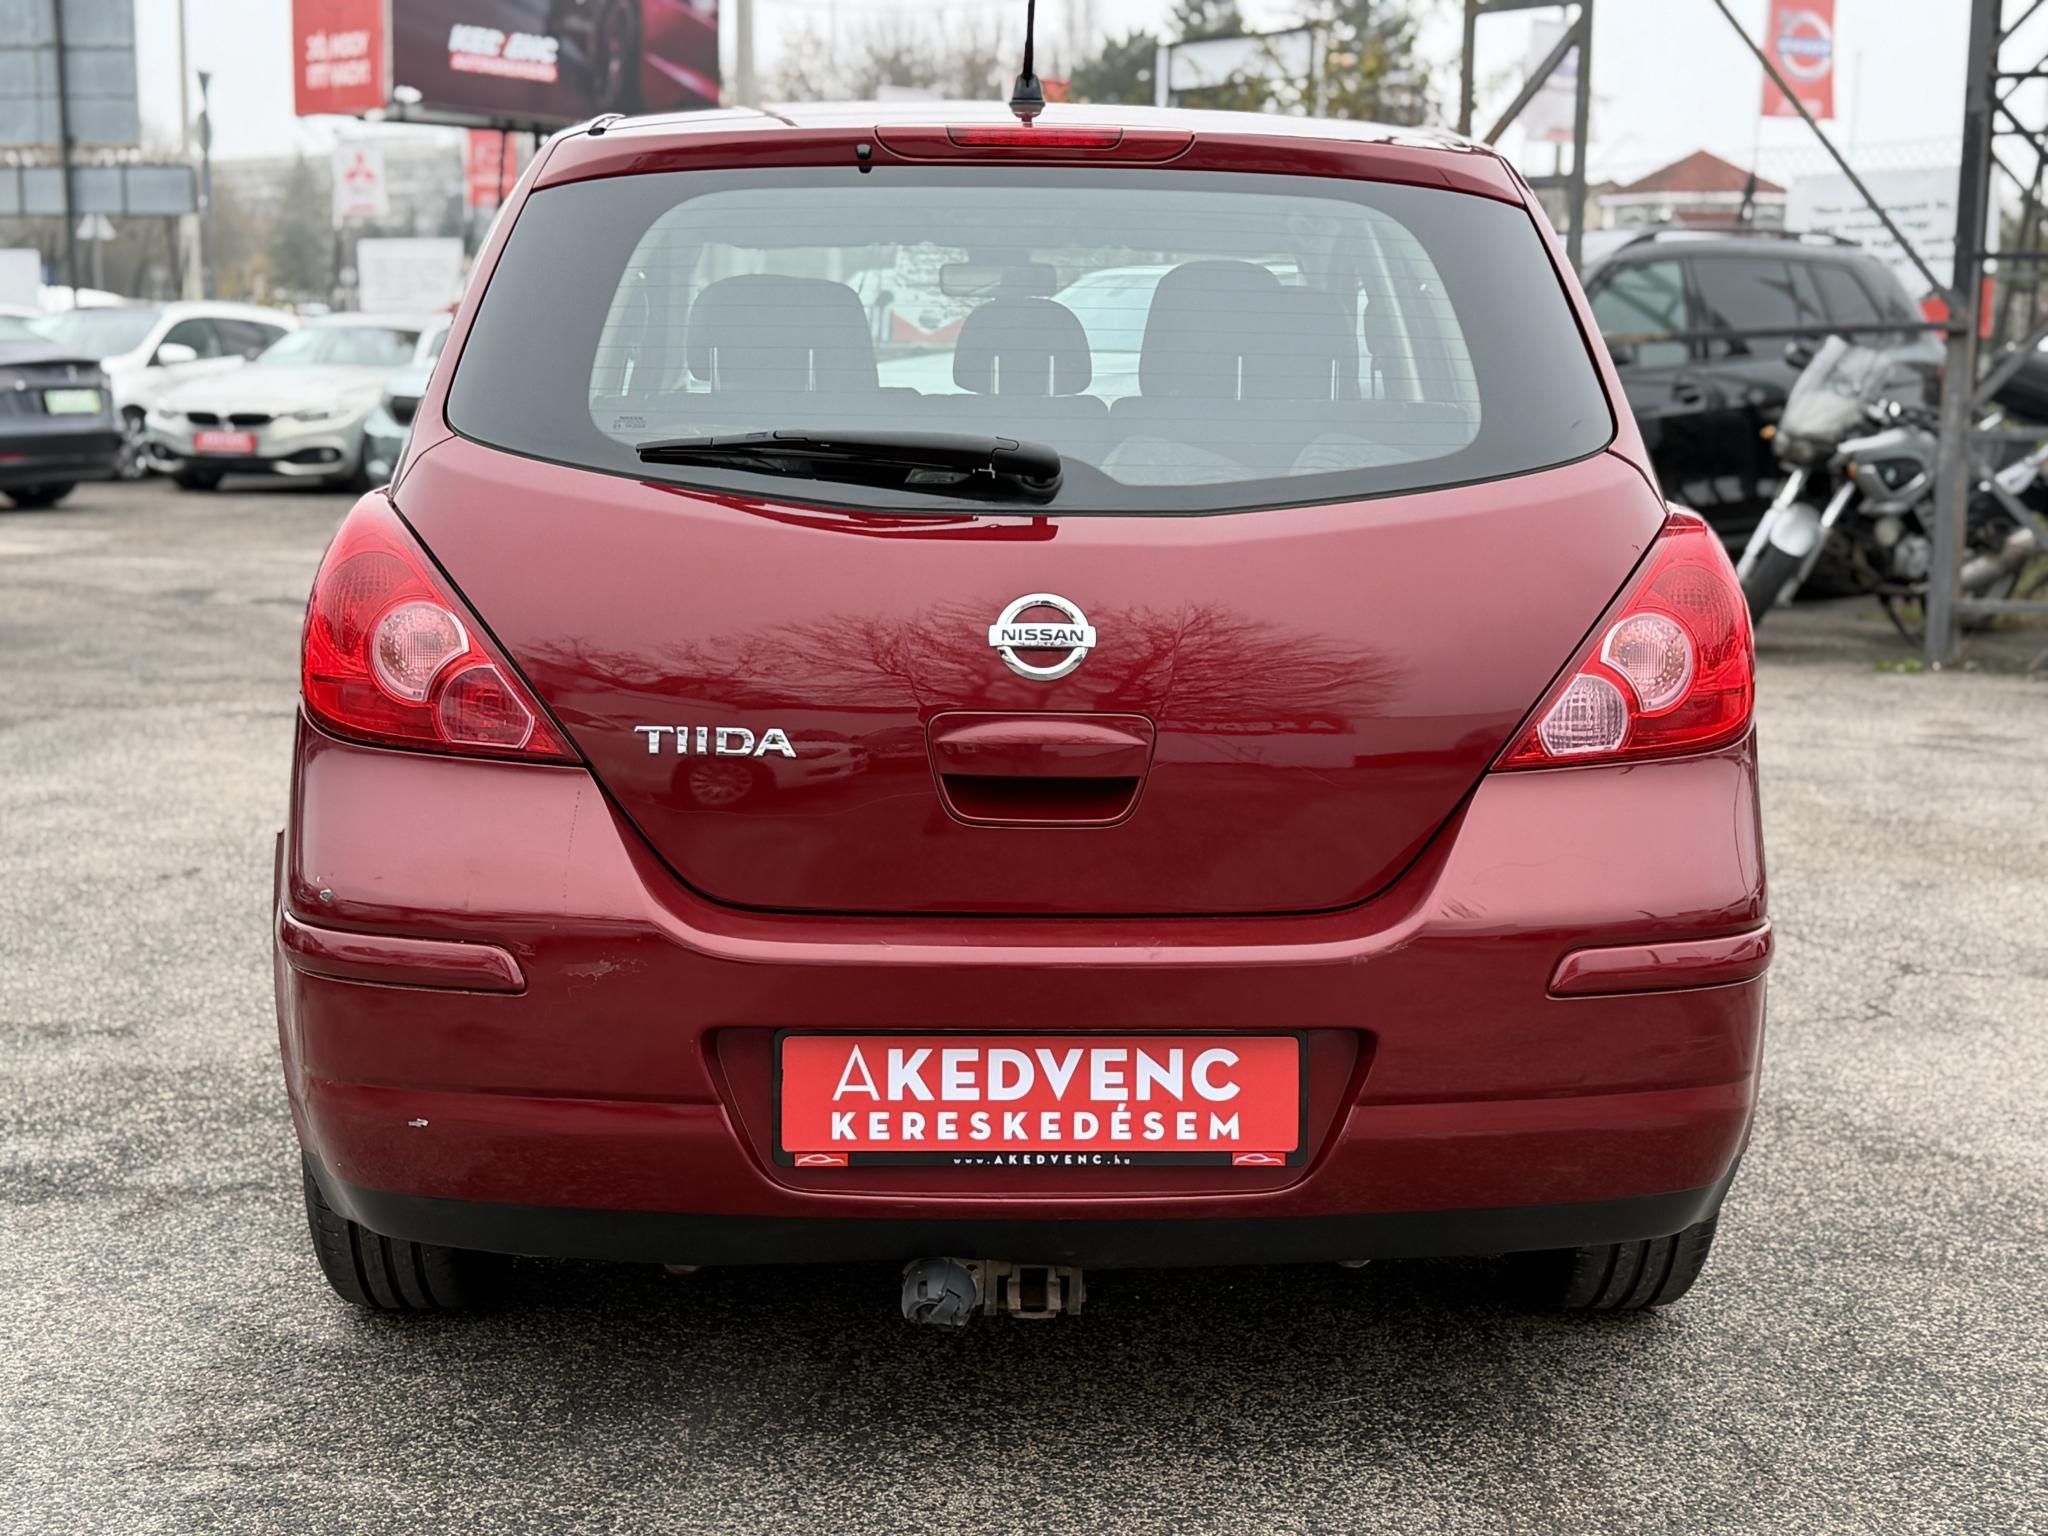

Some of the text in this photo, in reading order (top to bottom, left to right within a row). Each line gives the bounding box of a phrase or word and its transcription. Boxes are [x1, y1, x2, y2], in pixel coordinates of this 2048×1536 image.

[1001, 629, 1084, 642] NISSAN
[634, 725, 797, 758] TIIDA
[831, 1104, 1240, 1141] KERESKEDÉSEM
[953, 1154, 1131, 1165] www.AKEDVENC.hu
